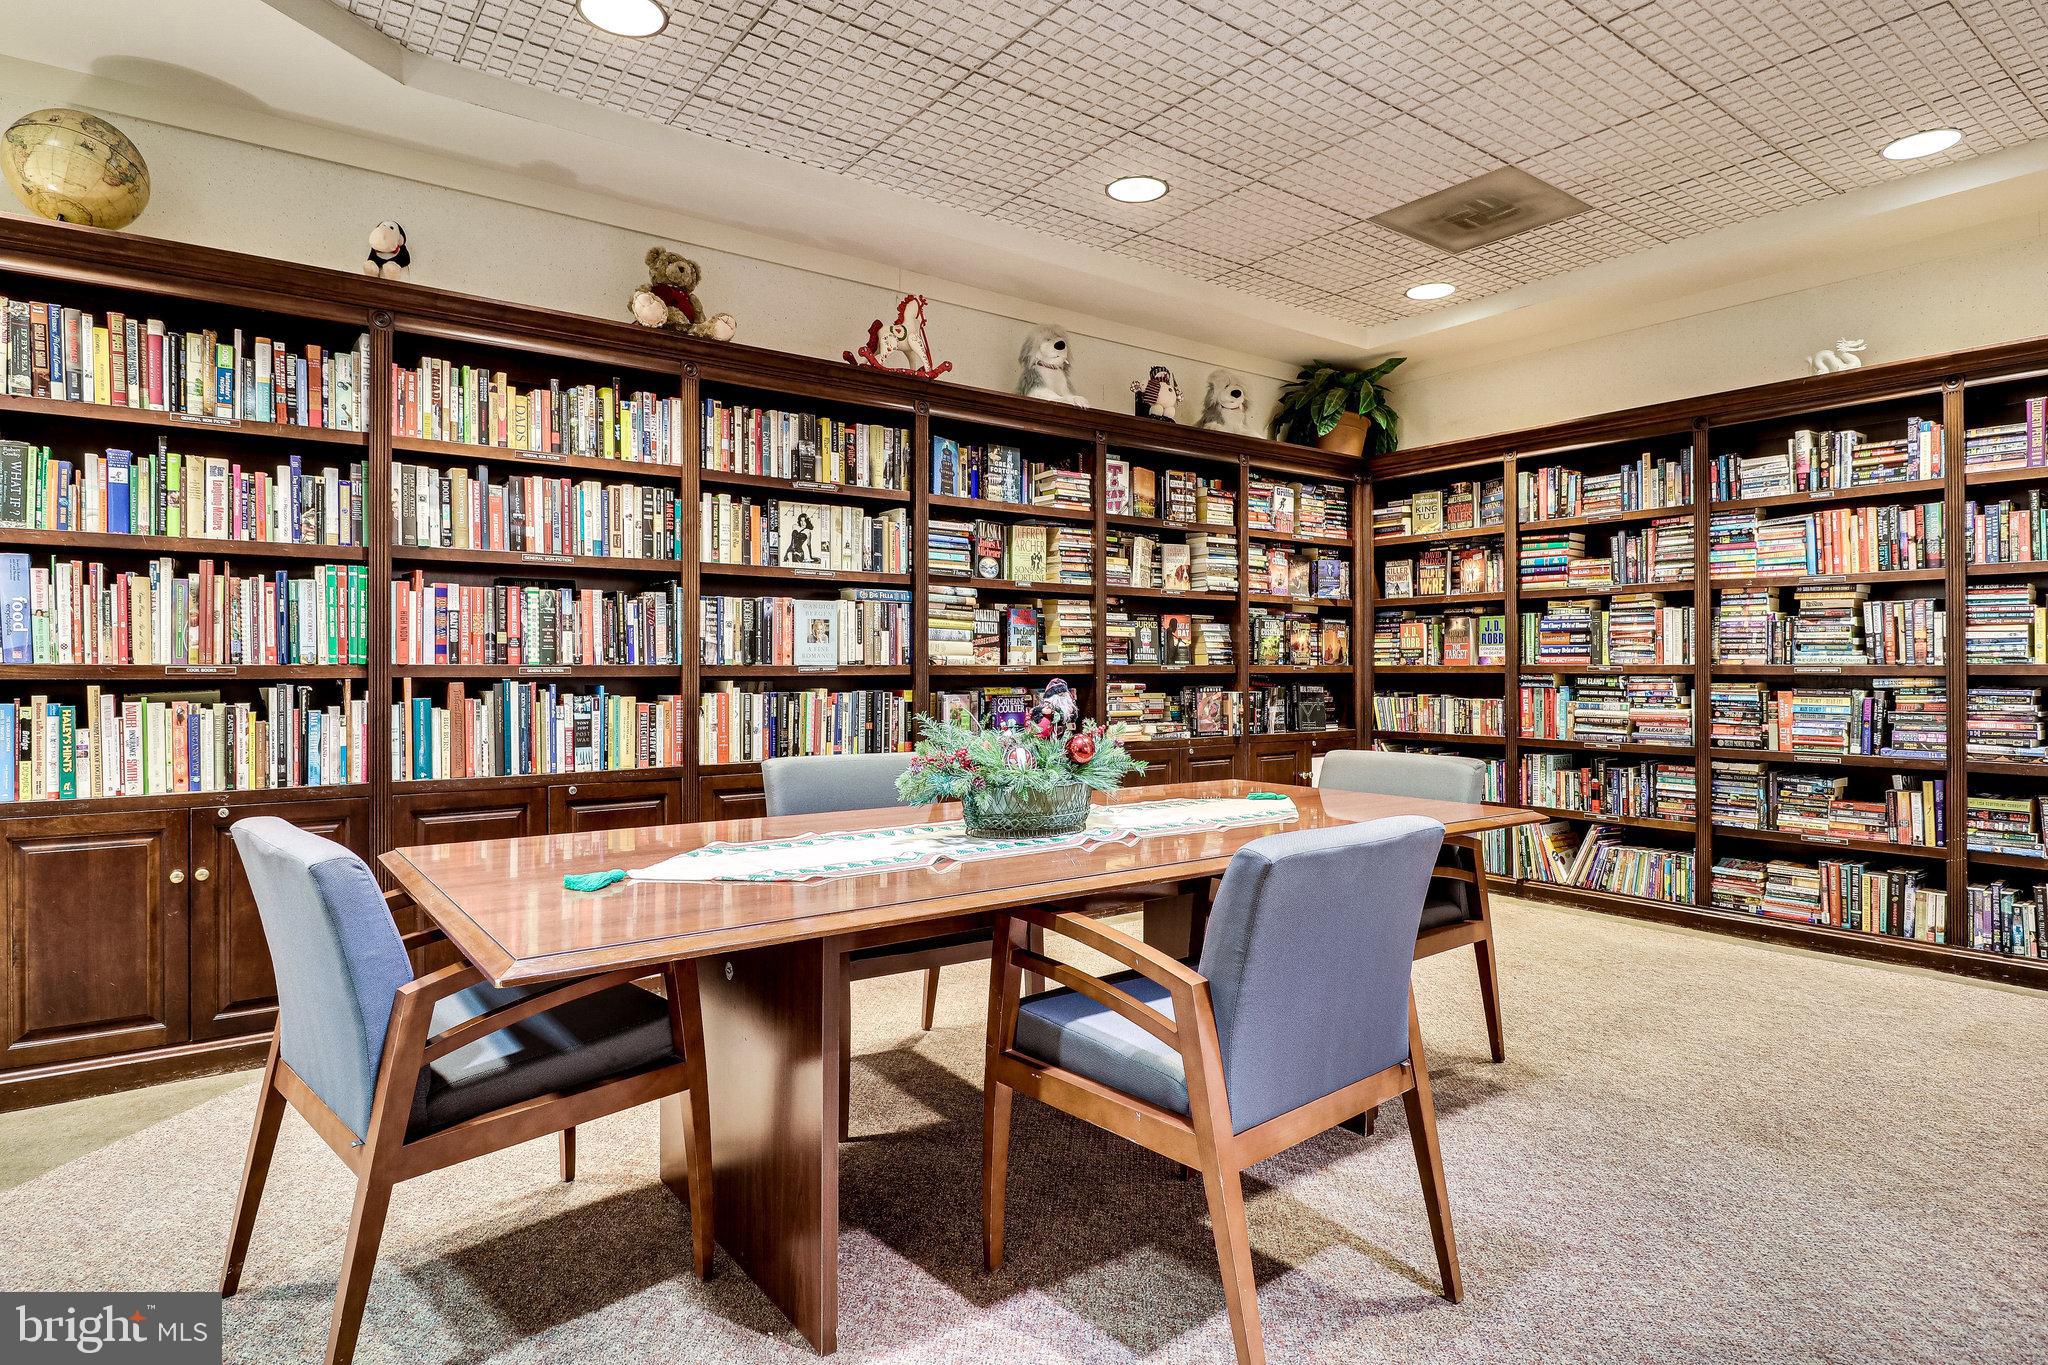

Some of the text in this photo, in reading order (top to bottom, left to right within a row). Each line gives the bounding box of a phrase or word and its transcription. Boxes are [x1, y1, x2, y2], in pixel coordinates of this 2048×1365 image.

[21, 338, 29, 349] BY
[21, 351, 29, 372] SEA
[362, 341, 372, 391] SPITFIRE
[515, 404, 527, 443] DADS
[2032, 401, 2043, 448] ELIZABETH PETERS
[989, 465, 1019, 475] FORTUNE
[994, 459, 1015, 468] GREAT
[10, 461, 22, 496] WHAT
[442, 481, 451, 502] BOOM!
[10, 497, 21, 506] IF
[212, 480, 225, 531] Laughing Matters
[457, 489, 466, 524] Greenspan
[1415, 504, 1438, 513] KING
[2031, 492, 2039, 510] KATHY
[666, 503, 674, 530] ANGLER
[1447, 512, 1473, 523] KILLERS
[1014, 540, 1045, 553] ARCHER
[1386, 566, 1408, 575] KILLER
[1419, 577, 1445, 595] WIRE
[1460, 581, 1480, 594] HEART
[4, 603, 13, 636] encyclopedia
[12, 597, 28, 632] food
[450, 612, 458, 628] CRAZY
[461, 595, 469, 635] HIGH-VELOCITY
[1134, 620, 1158, 629] BURKE
[1403, 627, 1410, 637] J.
[1484, 620, 1501, 632] J. D.
[1548, 622, 1561, 630] Clancy
[400, 626, 408, 642] NOON
[1177, 629, 1190, 638] BAT
[1481, 633, 1504, 645] ROBB
[1401, 637, 1421, 648] ROBB
[1548, 647, 1561, 655] Clancy
[1577, 677, 1606, 686] TOM CLANCY
[996, 696, 1025, 706] CATHERINE
[997, 704, 1025, 714] COULTER
[126, 704, 138, 728] NADER
[640, 712, 648, 735] PUBLIC
[1642, 726, 1673, 734] PARANOIA
[21, 730, 30, 751] Bridge
[62, 709, 73, 773] HALEY'S HINTS
[649, 728, 657, 753] SWERVE
[127, 759, 138, 782] SMITH
